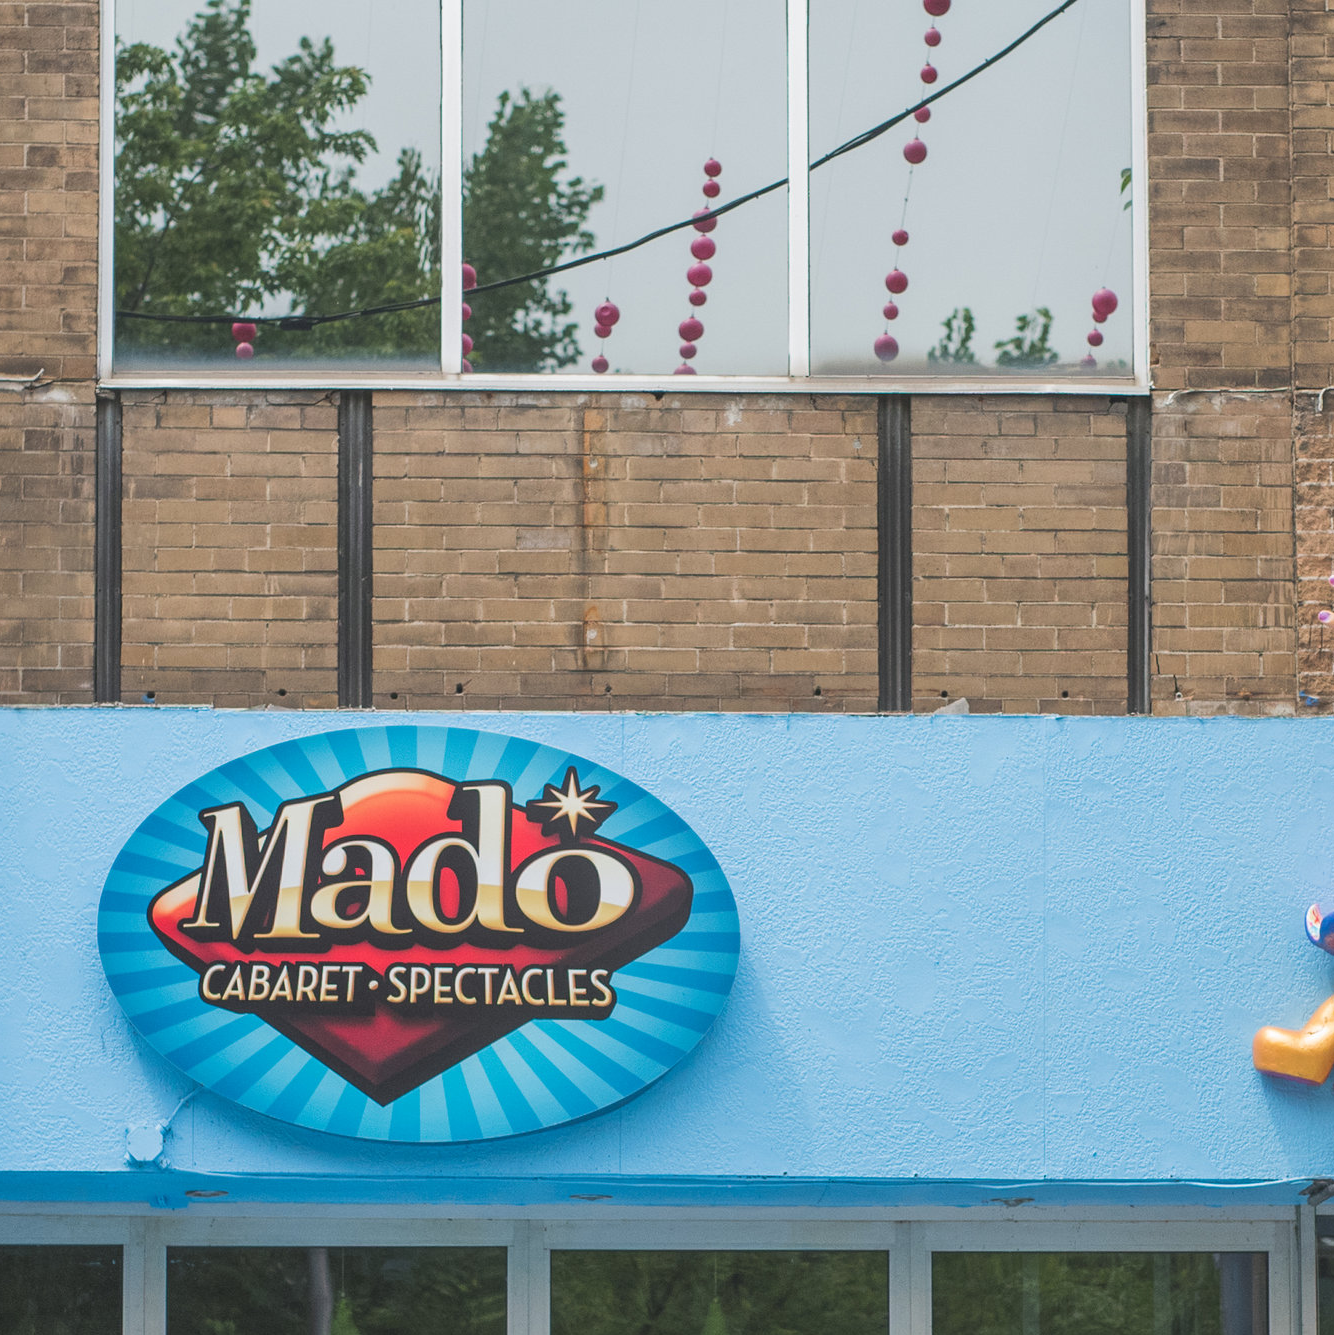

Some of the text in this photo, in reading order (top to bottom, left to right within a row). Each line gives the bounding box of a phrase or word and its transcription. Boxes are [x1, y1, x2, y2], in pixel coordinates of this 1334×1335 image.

[183, 784, 635, 940] Mado
[201, 963, 614, 1008] CABARET SPECTACLES
